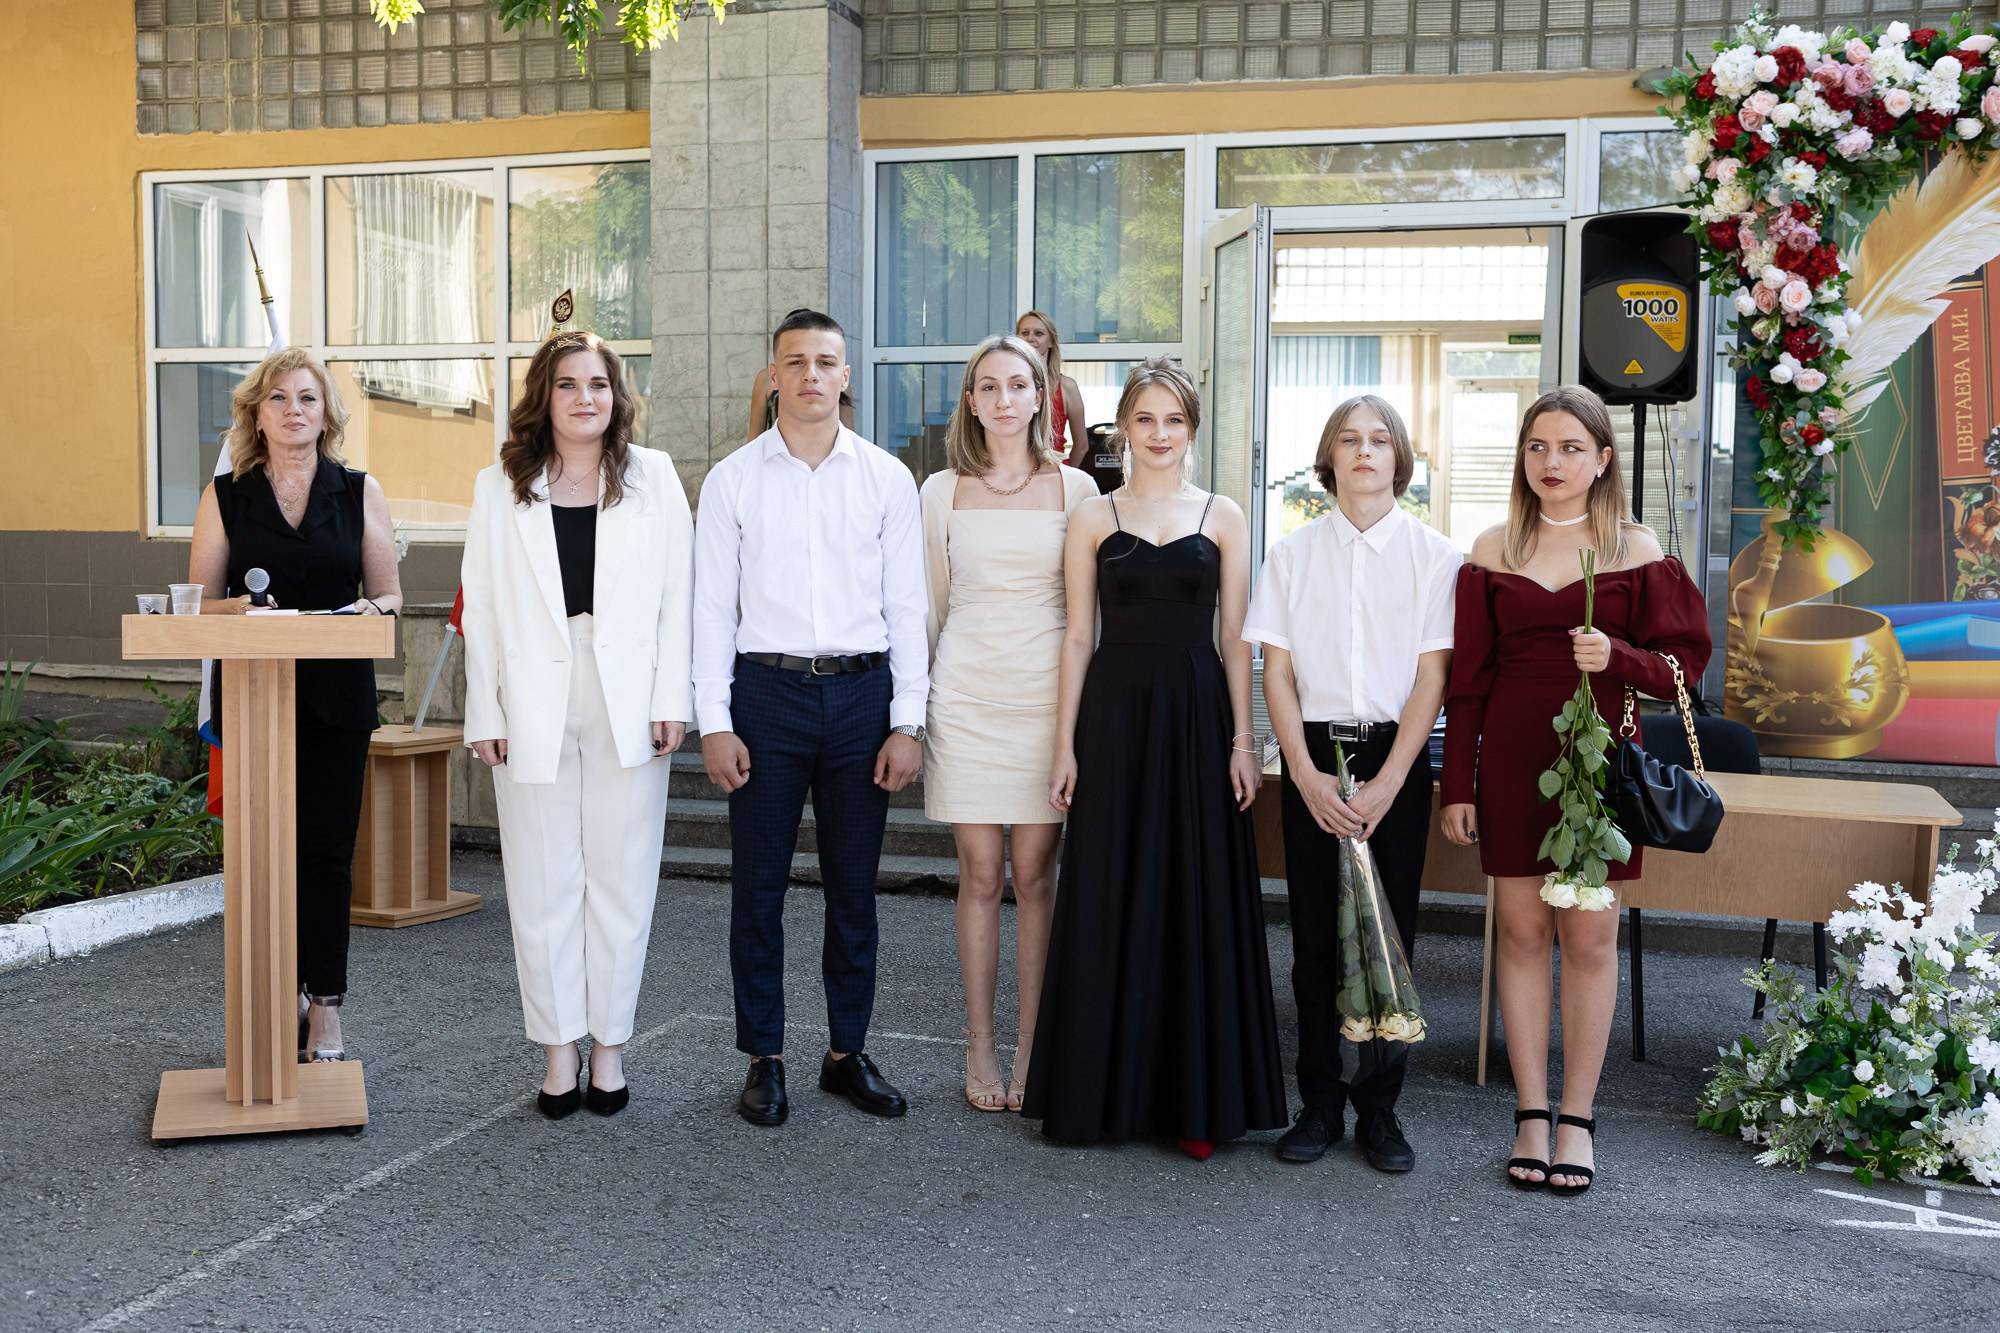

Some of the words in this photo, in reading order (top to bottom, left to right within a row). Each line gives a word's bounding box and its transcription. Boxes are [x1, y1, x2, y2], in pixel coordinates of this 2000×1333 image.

[1622, 298, 1680, 317] 1000
[1951, 308, 1970, 352] М.И.
[1953, 357, 1978, 463] ЦВЕТАЕВА
